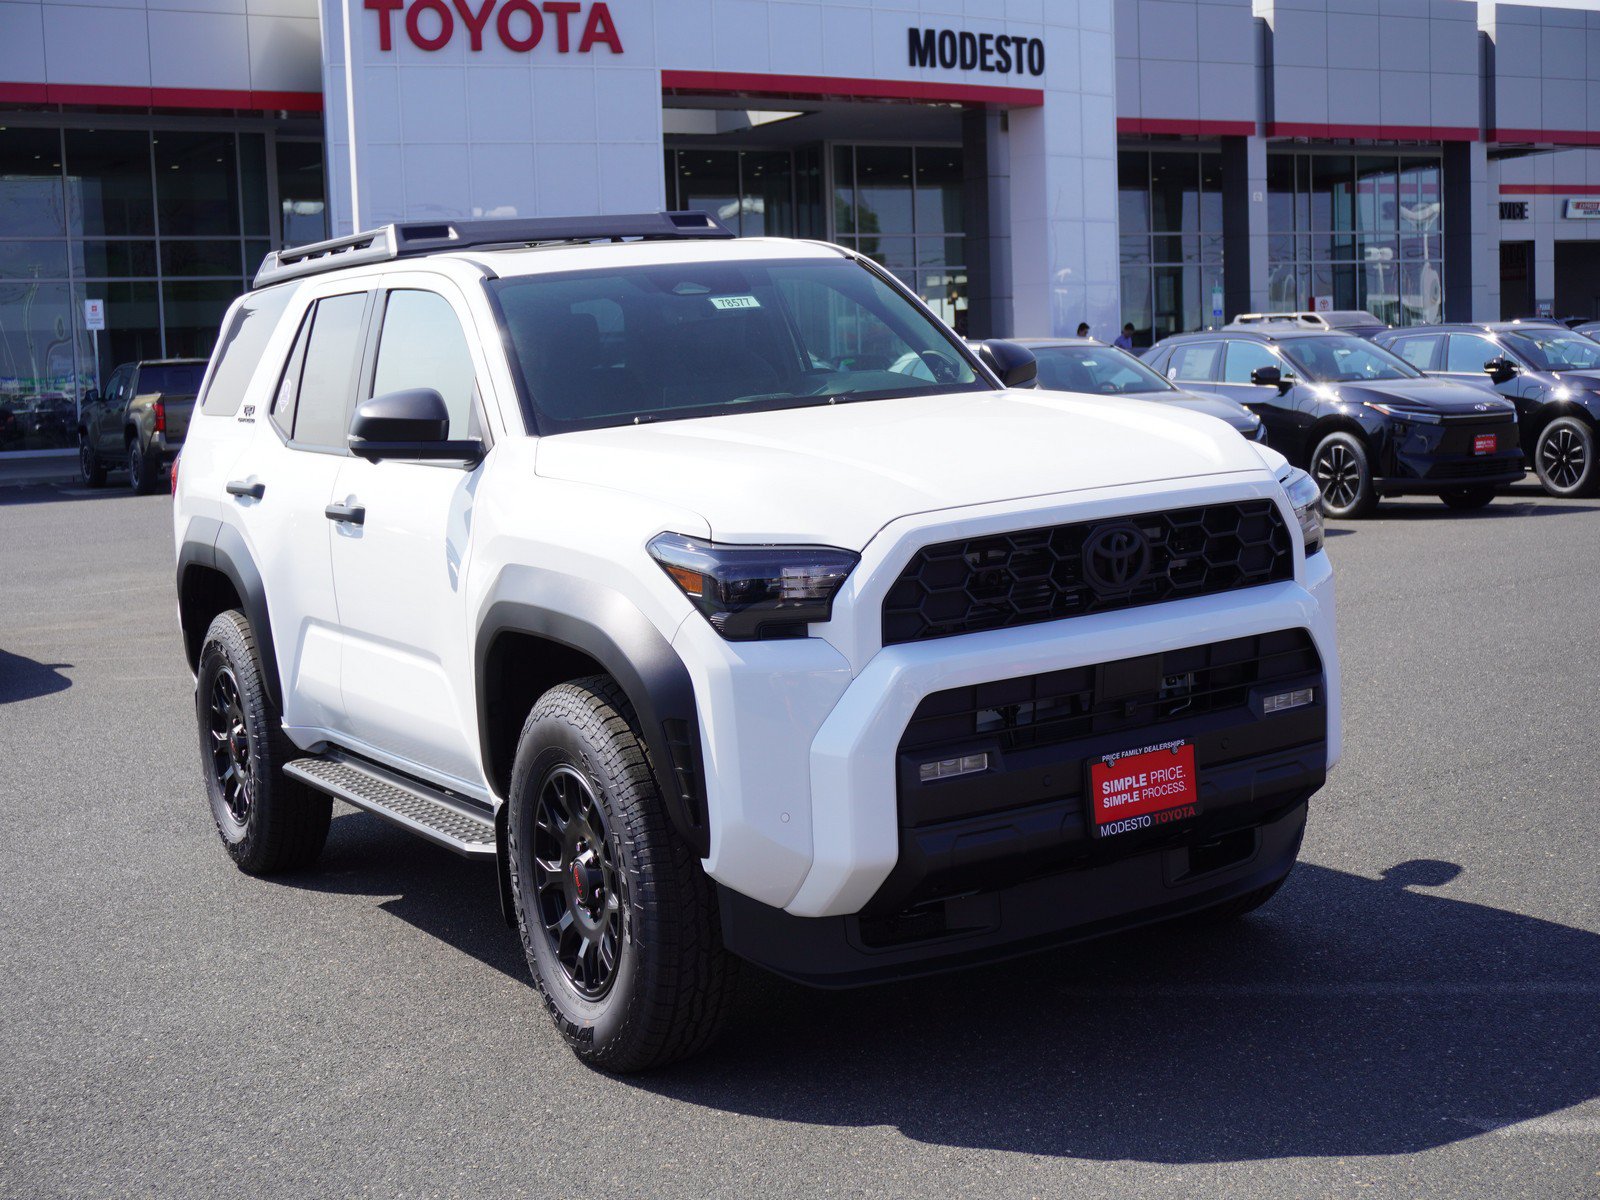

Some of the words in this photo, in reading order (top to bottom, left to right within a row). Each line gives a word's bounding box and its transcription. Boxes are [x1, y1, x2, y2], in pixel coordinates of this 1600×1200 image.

[364, 0, 624, 54] TOYOTA
[908, 27, 1045, 76] MODESTO
[717, 297, 751, 308] 78577
[1102, 752, 1120, 762] PRICE
[1121, 748, 1143, 759] FAMILY
[1144, 739, 1185, 754] DEALERSHIPS
[1102, 773, 1148, 795] SIMPLE
[1150, 765, 1187, 784] PRICE.
[1103, 791, 1140, 809] SIMPLE
[1142, 780, 1188, 800] PROCESS.
[1100, 815, 1151, 837] MODESTO
[1154, 806, 1196, 824] TOYOTA
